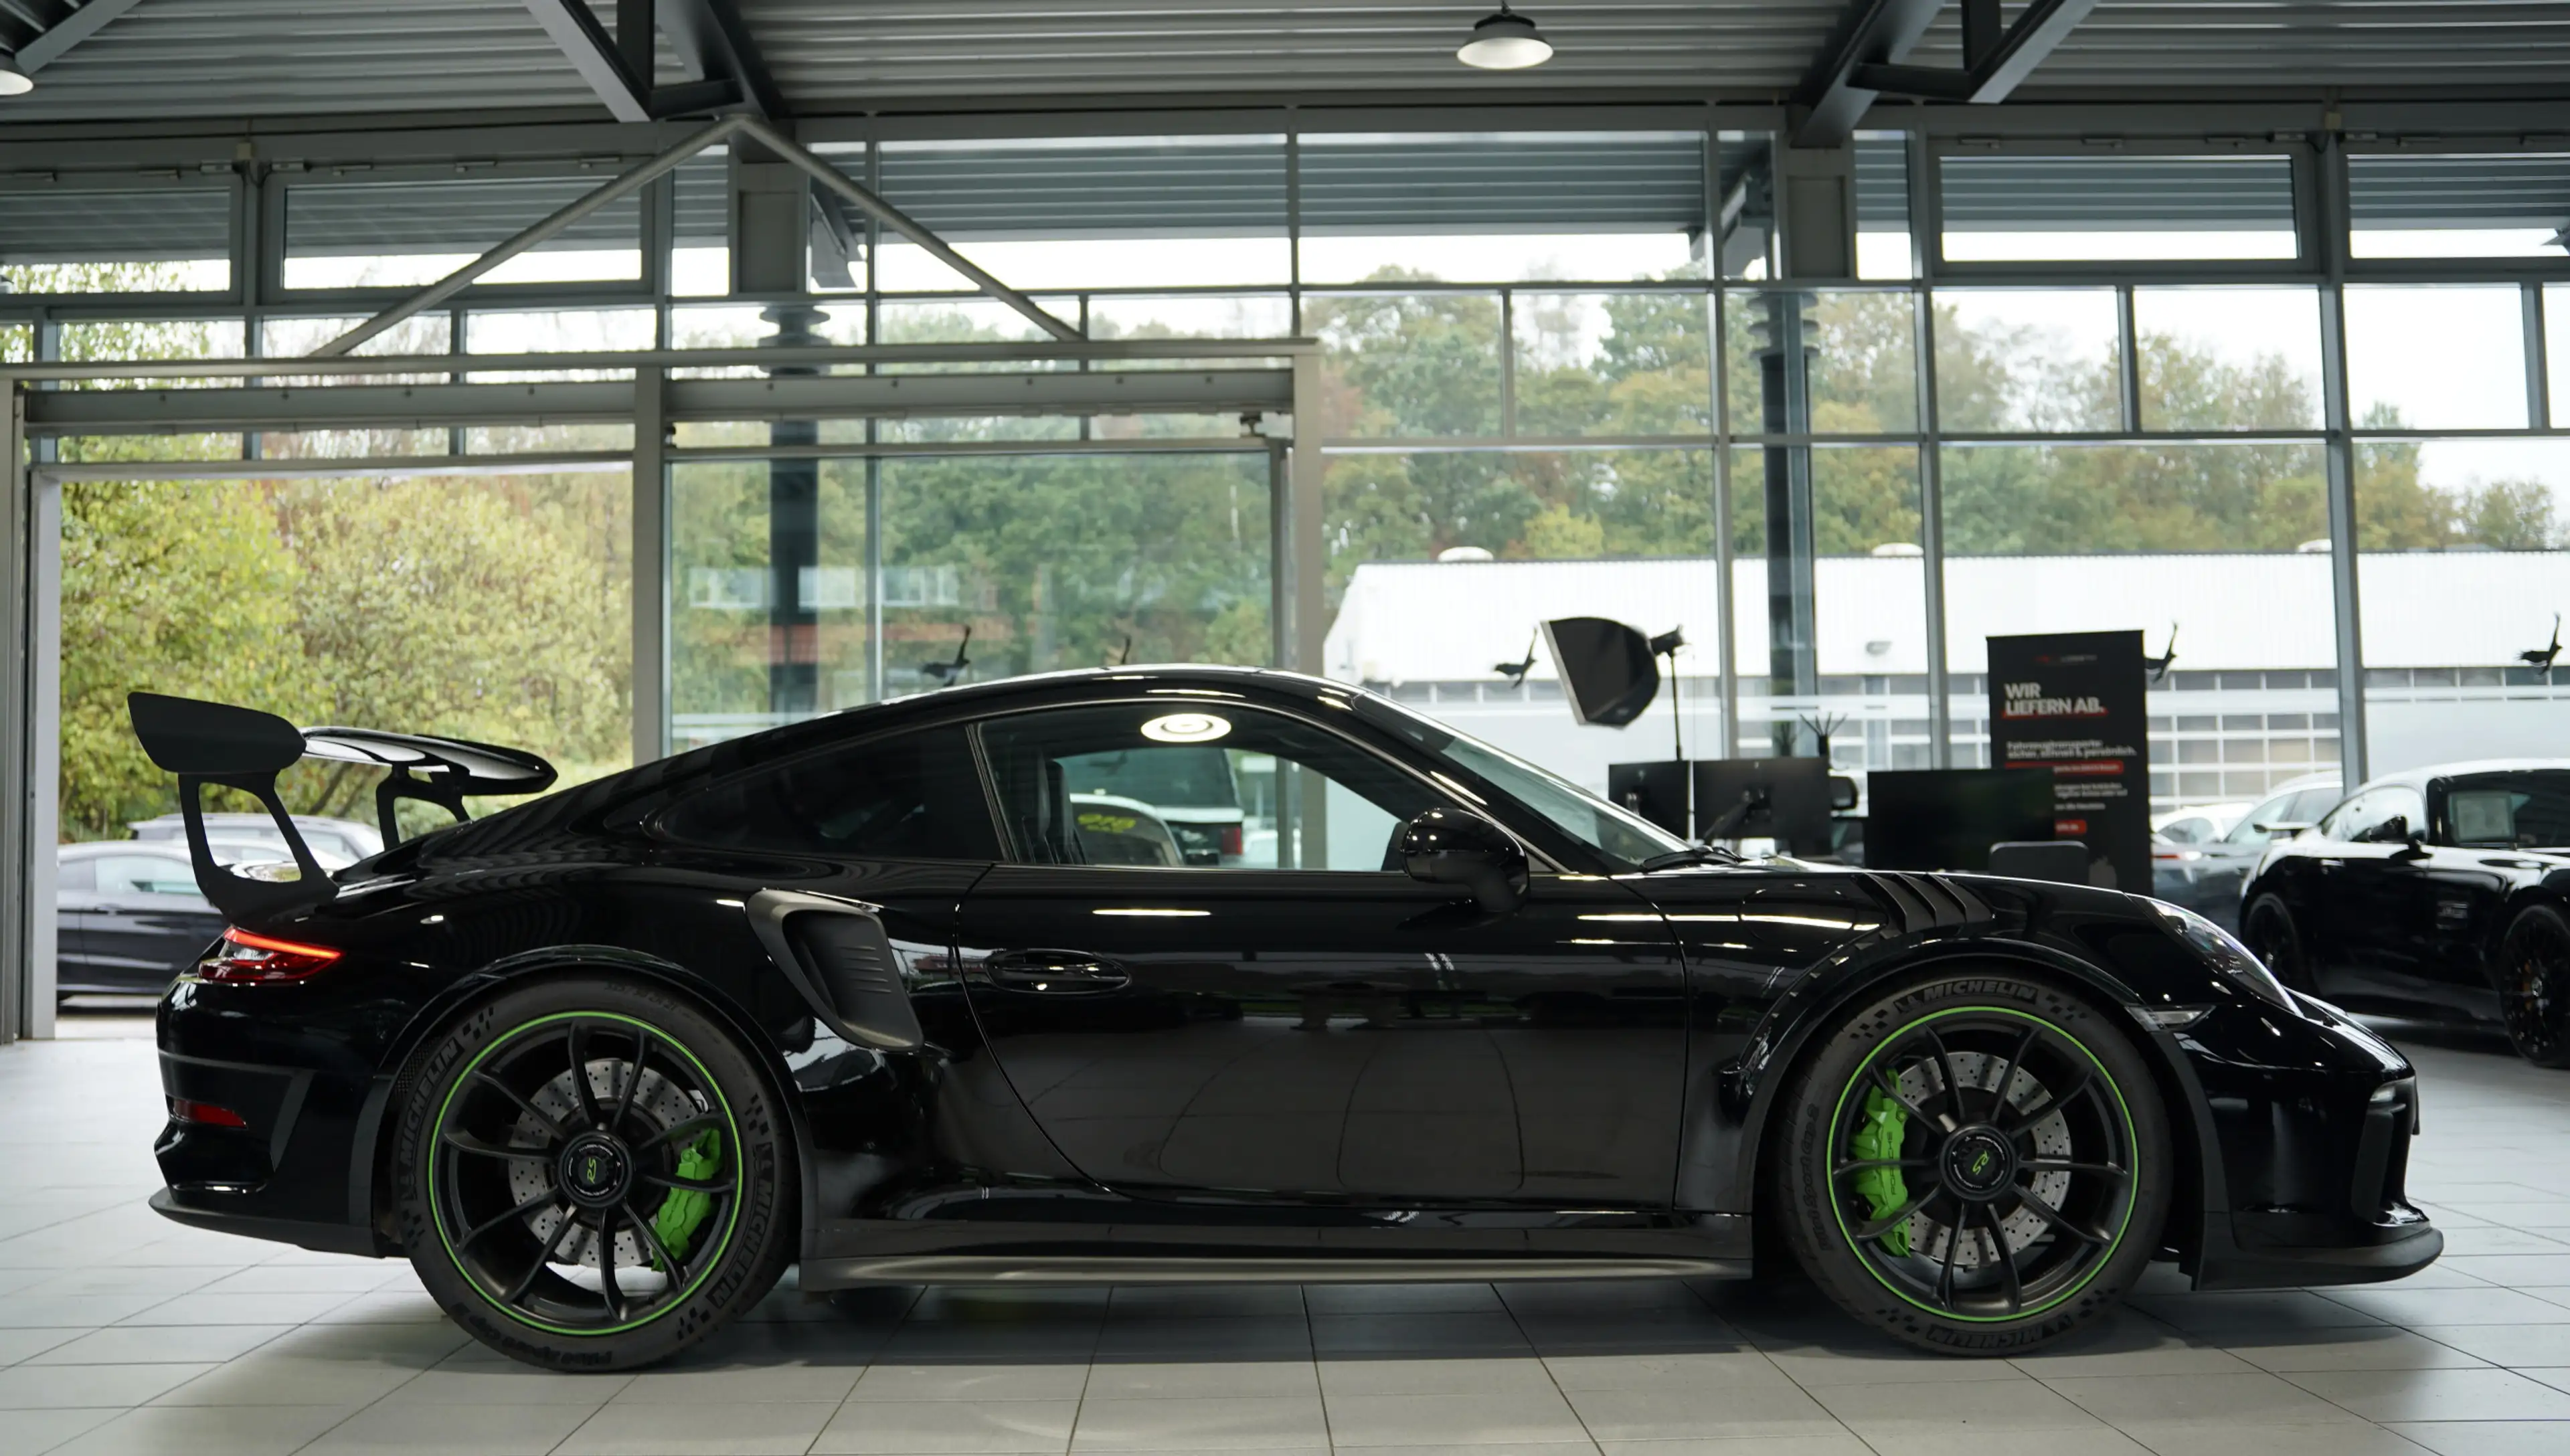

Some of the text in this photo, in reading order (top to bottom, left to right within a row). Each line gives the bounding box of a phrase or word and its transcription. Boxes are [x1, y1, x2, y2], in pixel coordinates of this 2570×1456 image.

[2004, 682, 2041, 699] WIR
[2005, 697, 2106, 716] LIEFERN AB.
[1924, 980, 2037, 1001] MICHELIN
[400, 1039, 458, 1166] MICHELIN
[1801, 1121, 1816, 1155] Cup
[586, 1156, 597, 1184] RS
[1887, 1132, 1897, 1195] PORCHE
[1972, 1150, 1990, 1176] RS
[1800, 1157, 1818, 1208] Sport
[712, 1180, 773, 1307] MICHELIN
[1929, 1326, 2043, 1348] MICHELIN
